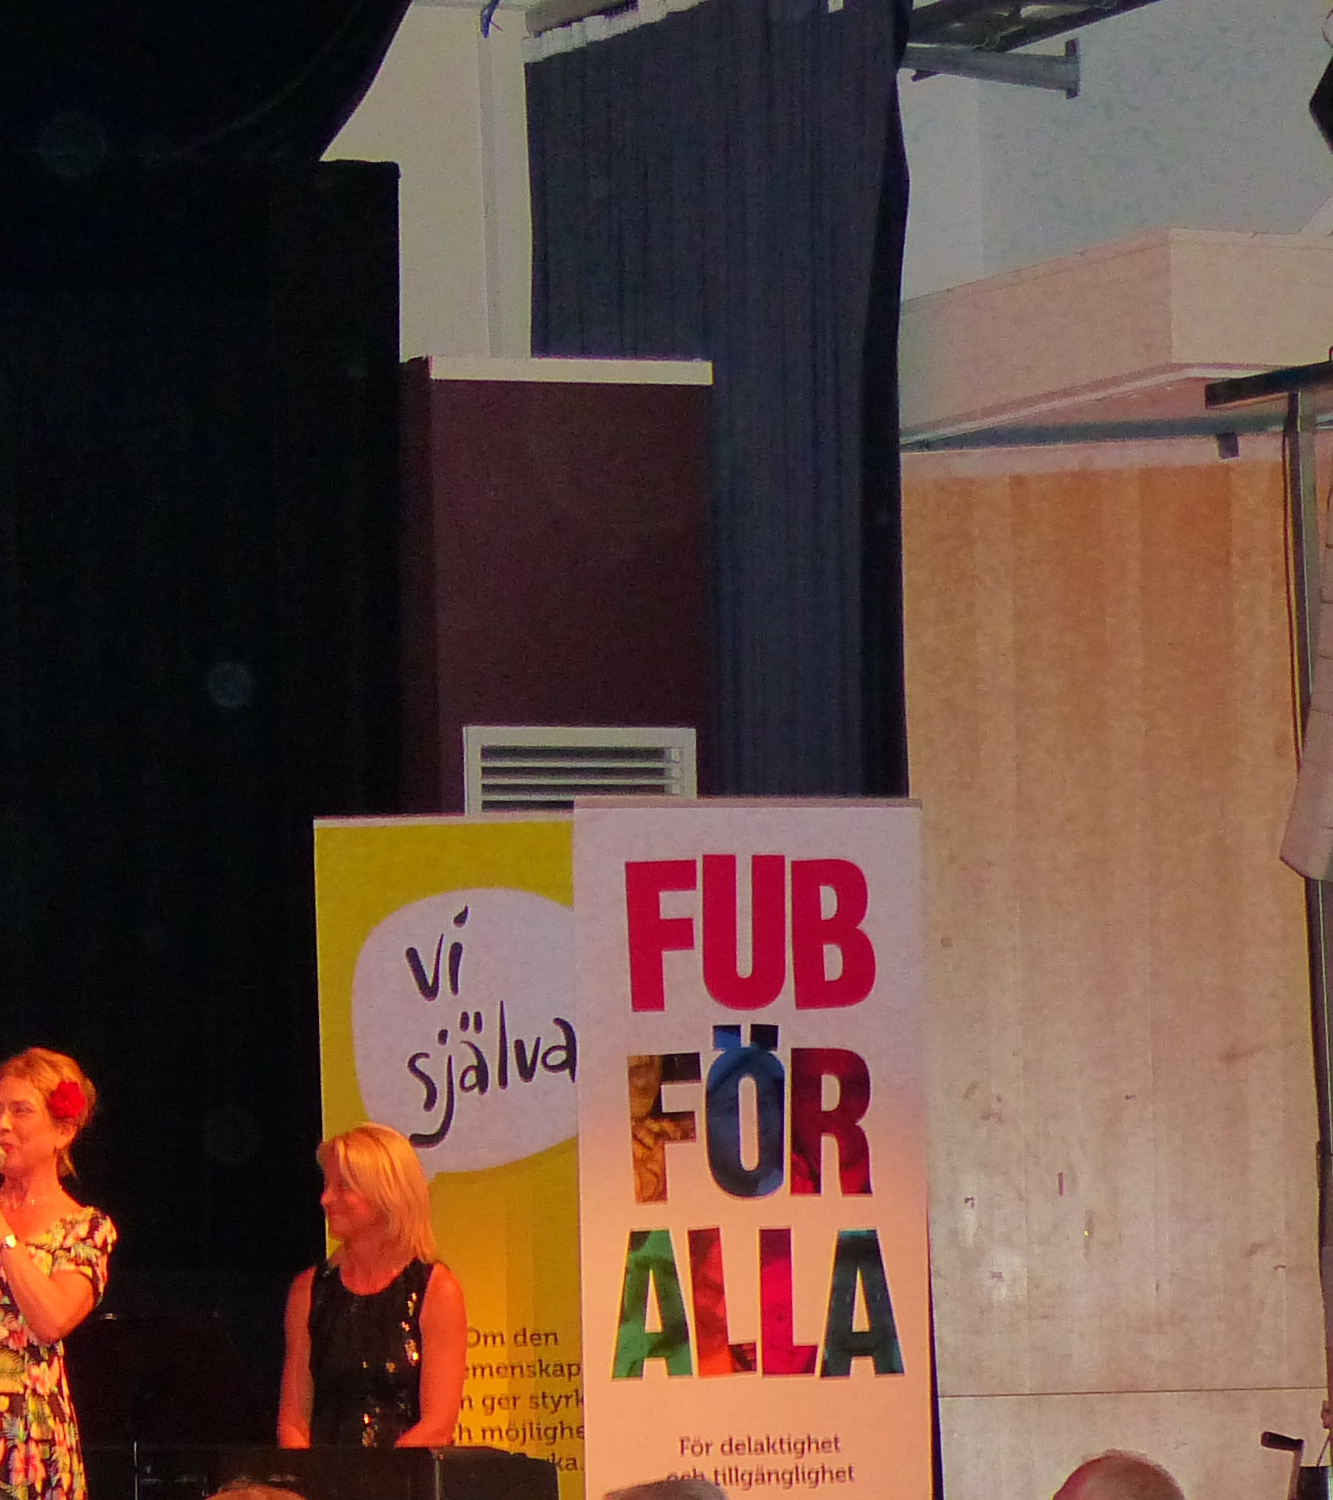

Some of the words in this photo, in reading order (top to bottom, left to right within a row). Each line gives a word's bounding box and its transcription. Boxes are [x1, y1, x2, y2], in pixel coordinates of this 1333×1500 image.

[405, 905, 470, 1002] vi
[625, 854, 877, 1012] FUB
[407, 1000, 578, 1148] själva
[627, 1024, 874, 1203] FÖR
[467, 1328, 505, 1347] Om
[514, 1327, 559, 1347] den
[611, 1227, 905, 1380] ALLA
[481, 1394, 521, 1416] ger
[679, 1435, 713, 1457] För
[720, 1433, 842, 1459] delaktighet
[713, 1463, 856, 1491] tillgänglighet
